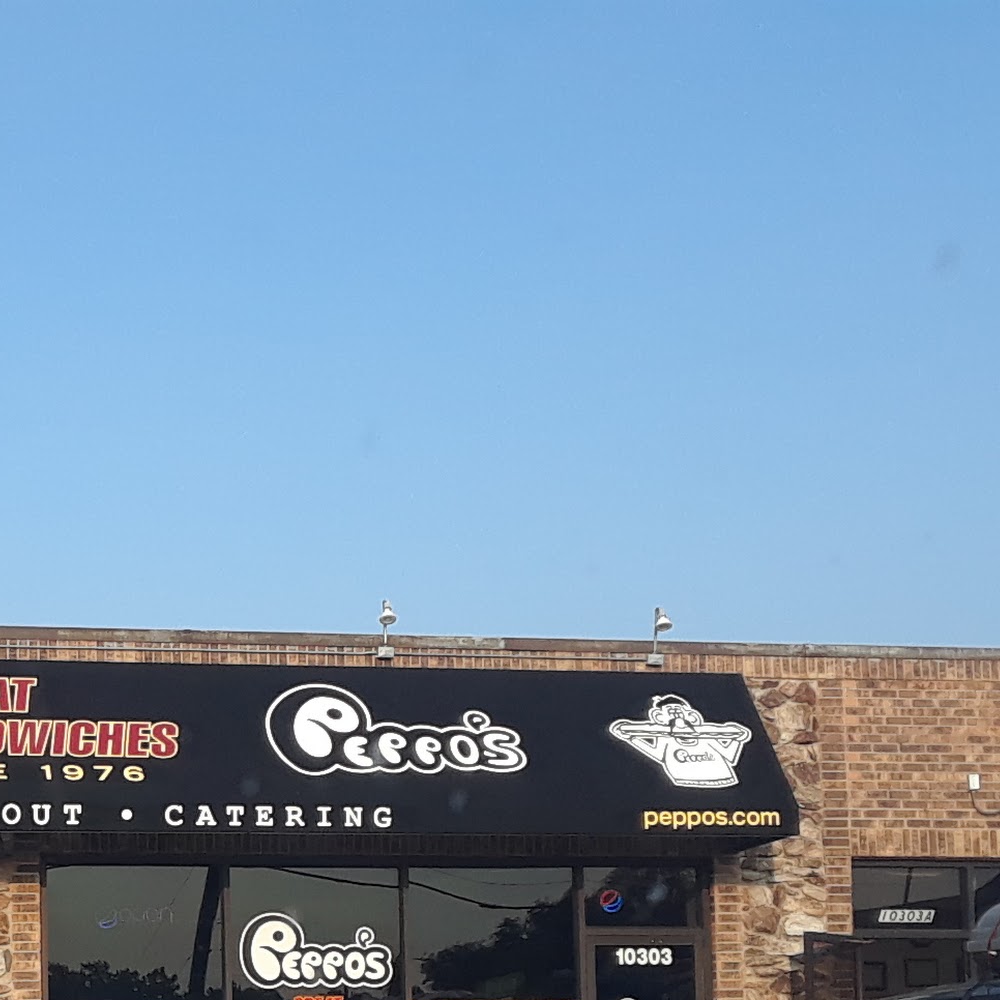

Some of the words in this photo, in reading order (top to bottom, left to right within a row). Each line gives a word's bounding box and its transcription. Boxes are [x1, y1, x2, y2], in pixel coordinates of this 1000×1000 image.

[41, 764, 146, 782] 1976
[164, 805, 393, 827] CATERING
[643, 808, 781, 830] peppos.com
[881, 910, 933, 922] 10303A
[615, 947, 673, 966] 10303
